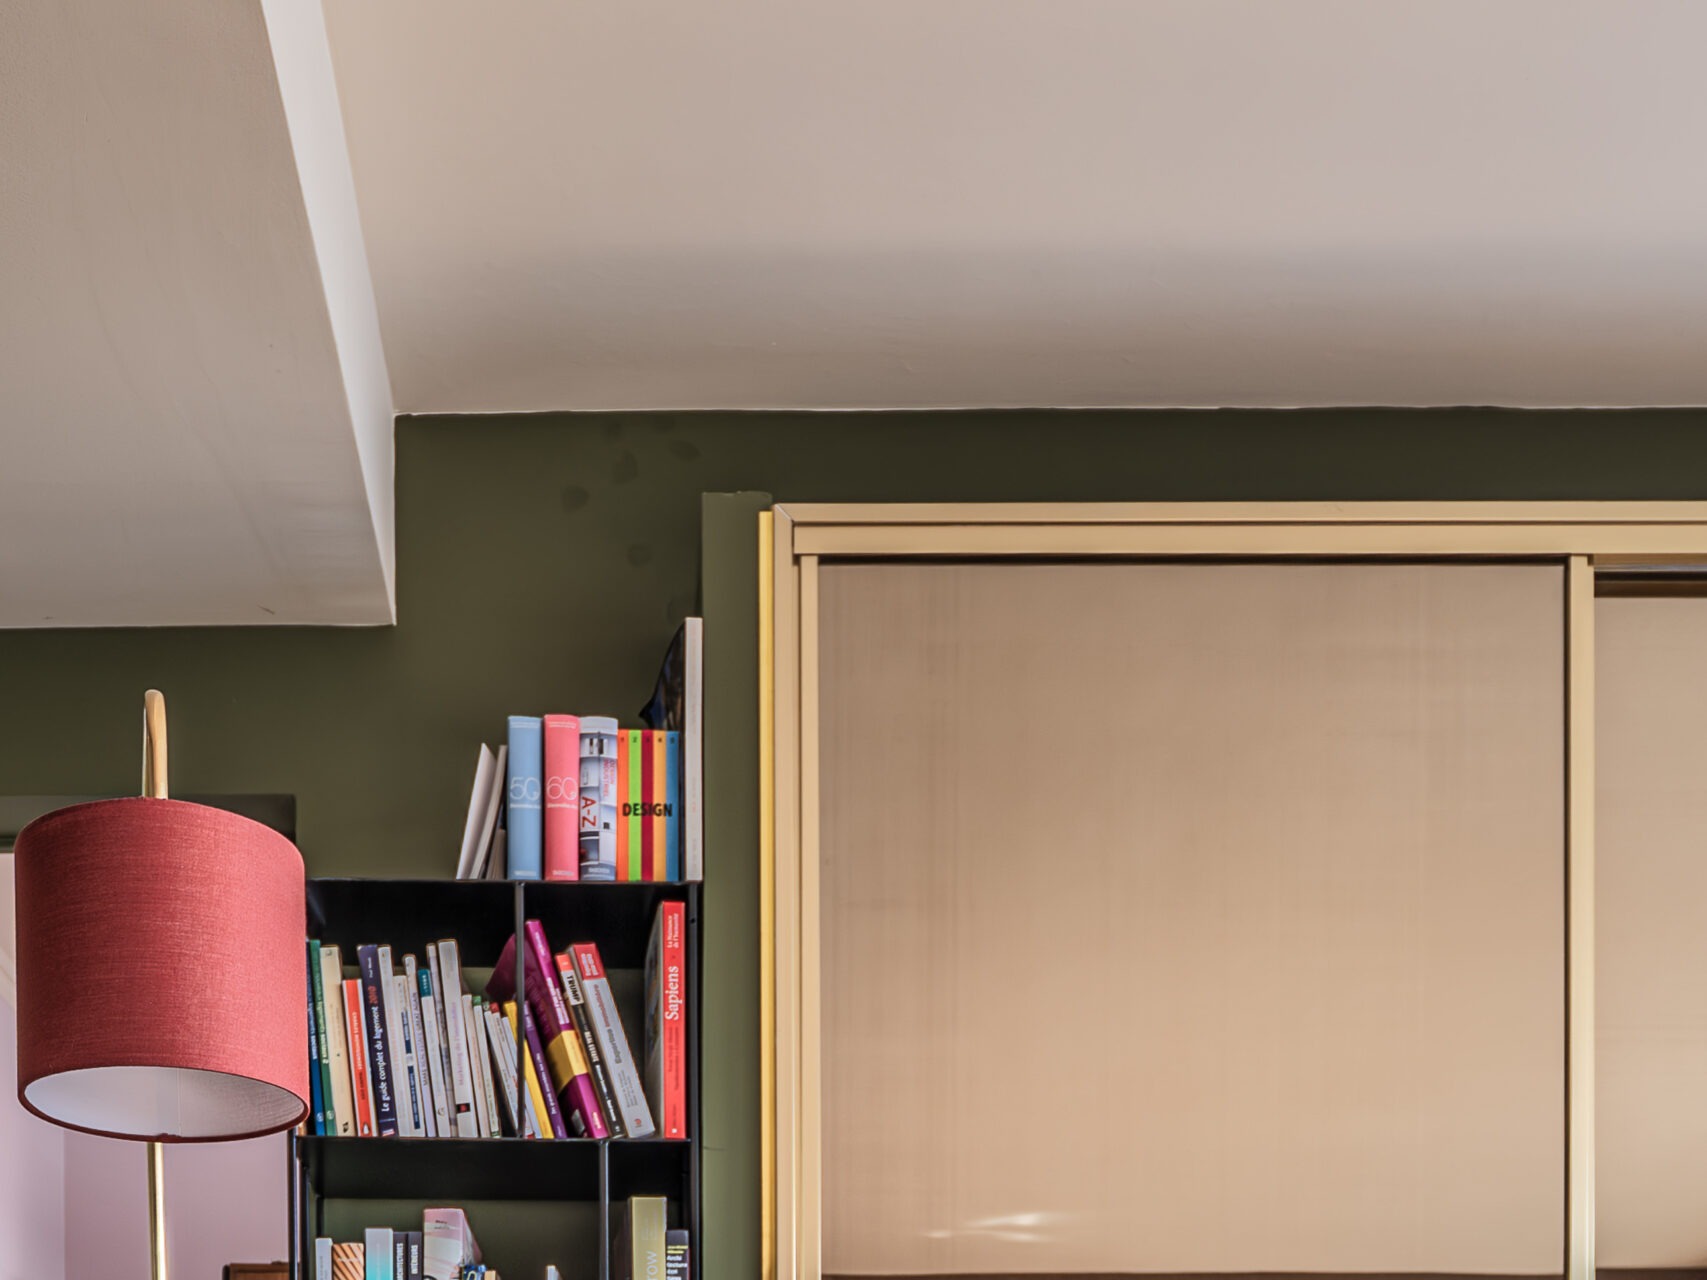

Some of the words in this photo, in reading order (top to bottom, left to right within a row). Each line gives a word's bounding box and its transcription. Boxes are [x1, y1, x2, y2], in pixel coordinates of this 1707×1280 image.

[582, 797, 597, 828] A-Z
[622, 803, 674, 816] DESIGN
[565, 974, 580, 1003] TRUMP
[664, 965, 682, 1020] Sapiens
[316, 1001, 324, 1032] logements
[351, 1011, 359, 1033] CHARLES
[369, 1005, 382, 1039] logement
[374, 1040, 382, 1050] du
[583, 1030, 593, 1044] REAL
[605, 1027, 623, 1064] Expertise
[375, 1051, 387, 1080] complet
[587, 1043, 599, 1062] ESTATE
[455, 1052, 465, 1085] Marketing
[378, 1080, 390, 1100] guide
[381, 1102, 389, 1111] Le
